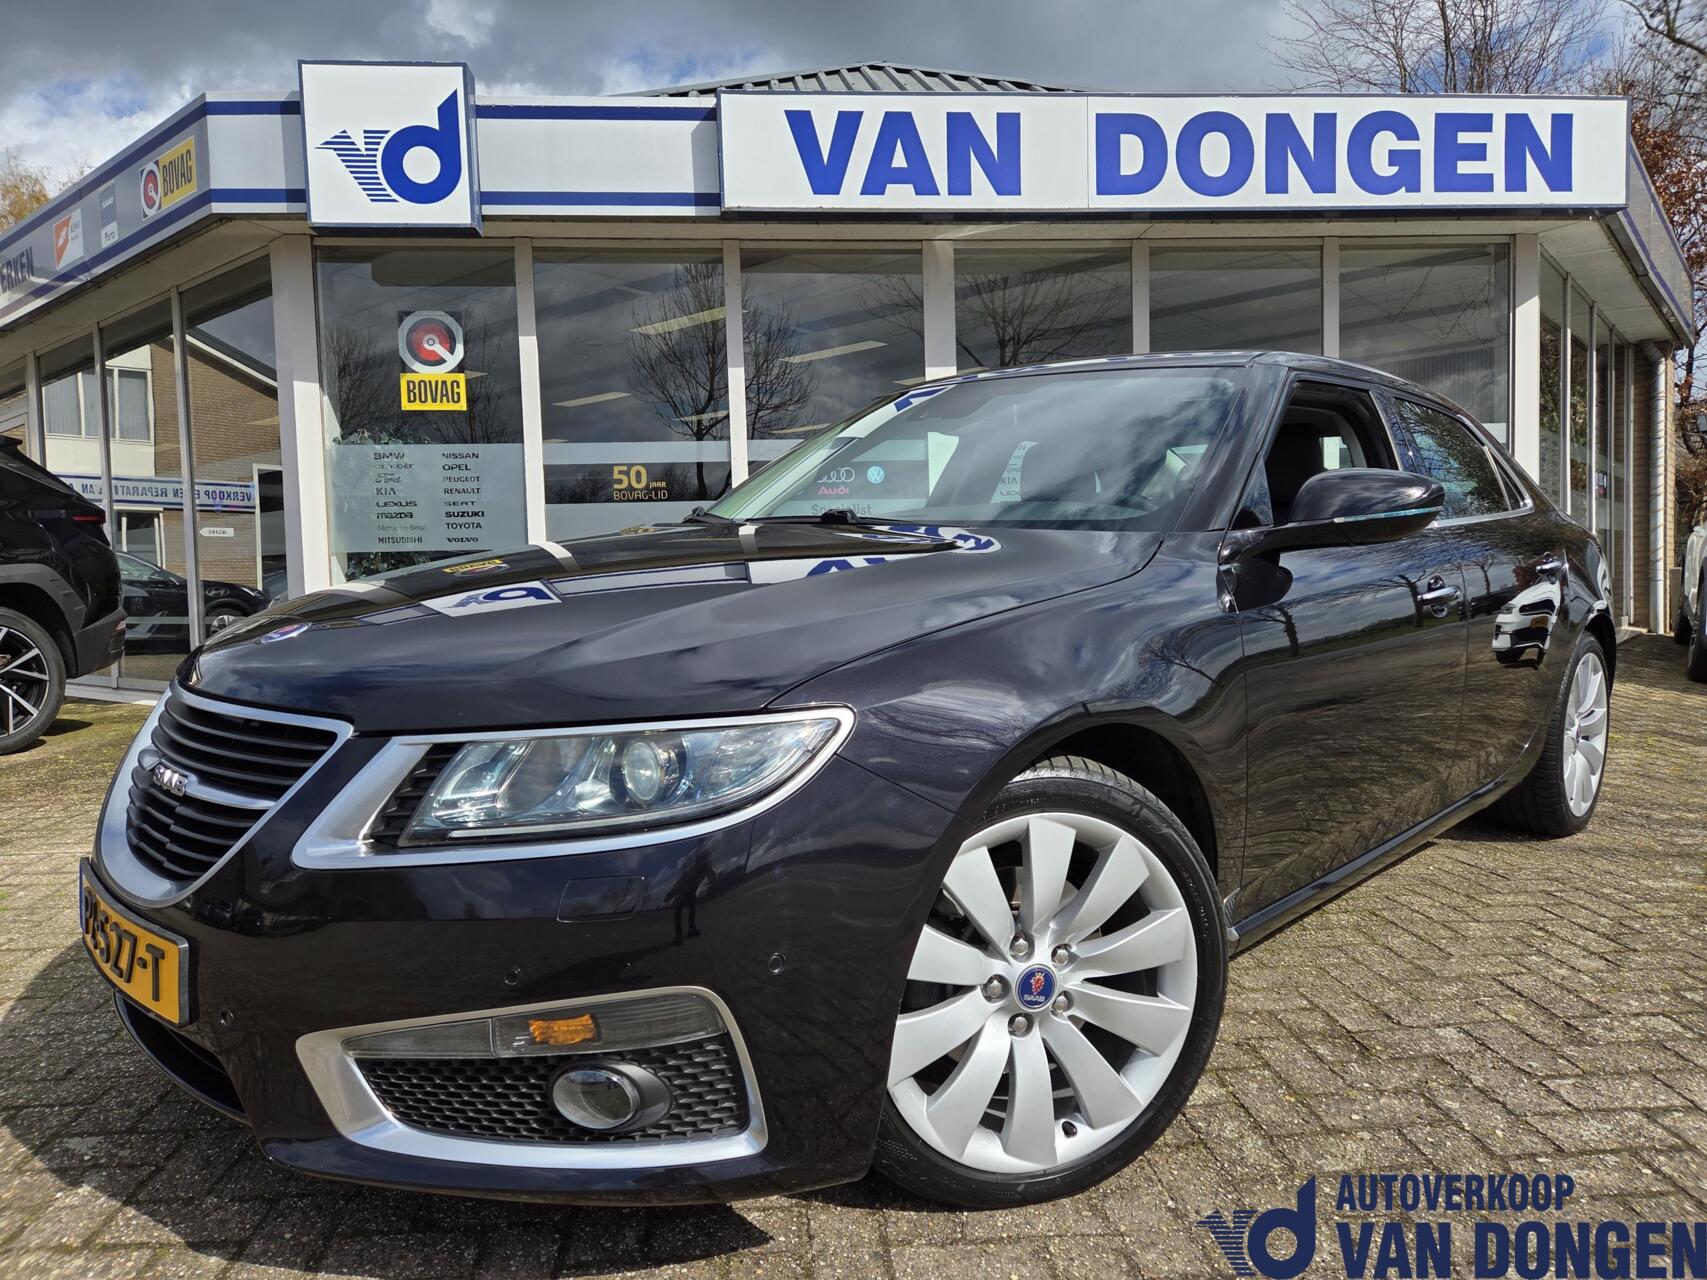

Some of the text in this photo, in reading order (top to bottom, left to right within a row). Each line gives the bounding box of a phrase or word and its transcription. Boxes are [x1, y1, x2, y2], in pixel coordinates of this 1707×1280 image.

[786, 110, 1573, 197] VAN DONGEN
[162, 149, 193, 197] BOVAG
[406, 379, 461, 404] BOVAG
[613, 465, 648, 489] 50
[376, 488, 397, 496] KIA
[613, 490, 669, 501] BOVAG-LID
[818, 486, 849, 496] Audi
[1023, 994, 1046, 1003] SAAB
